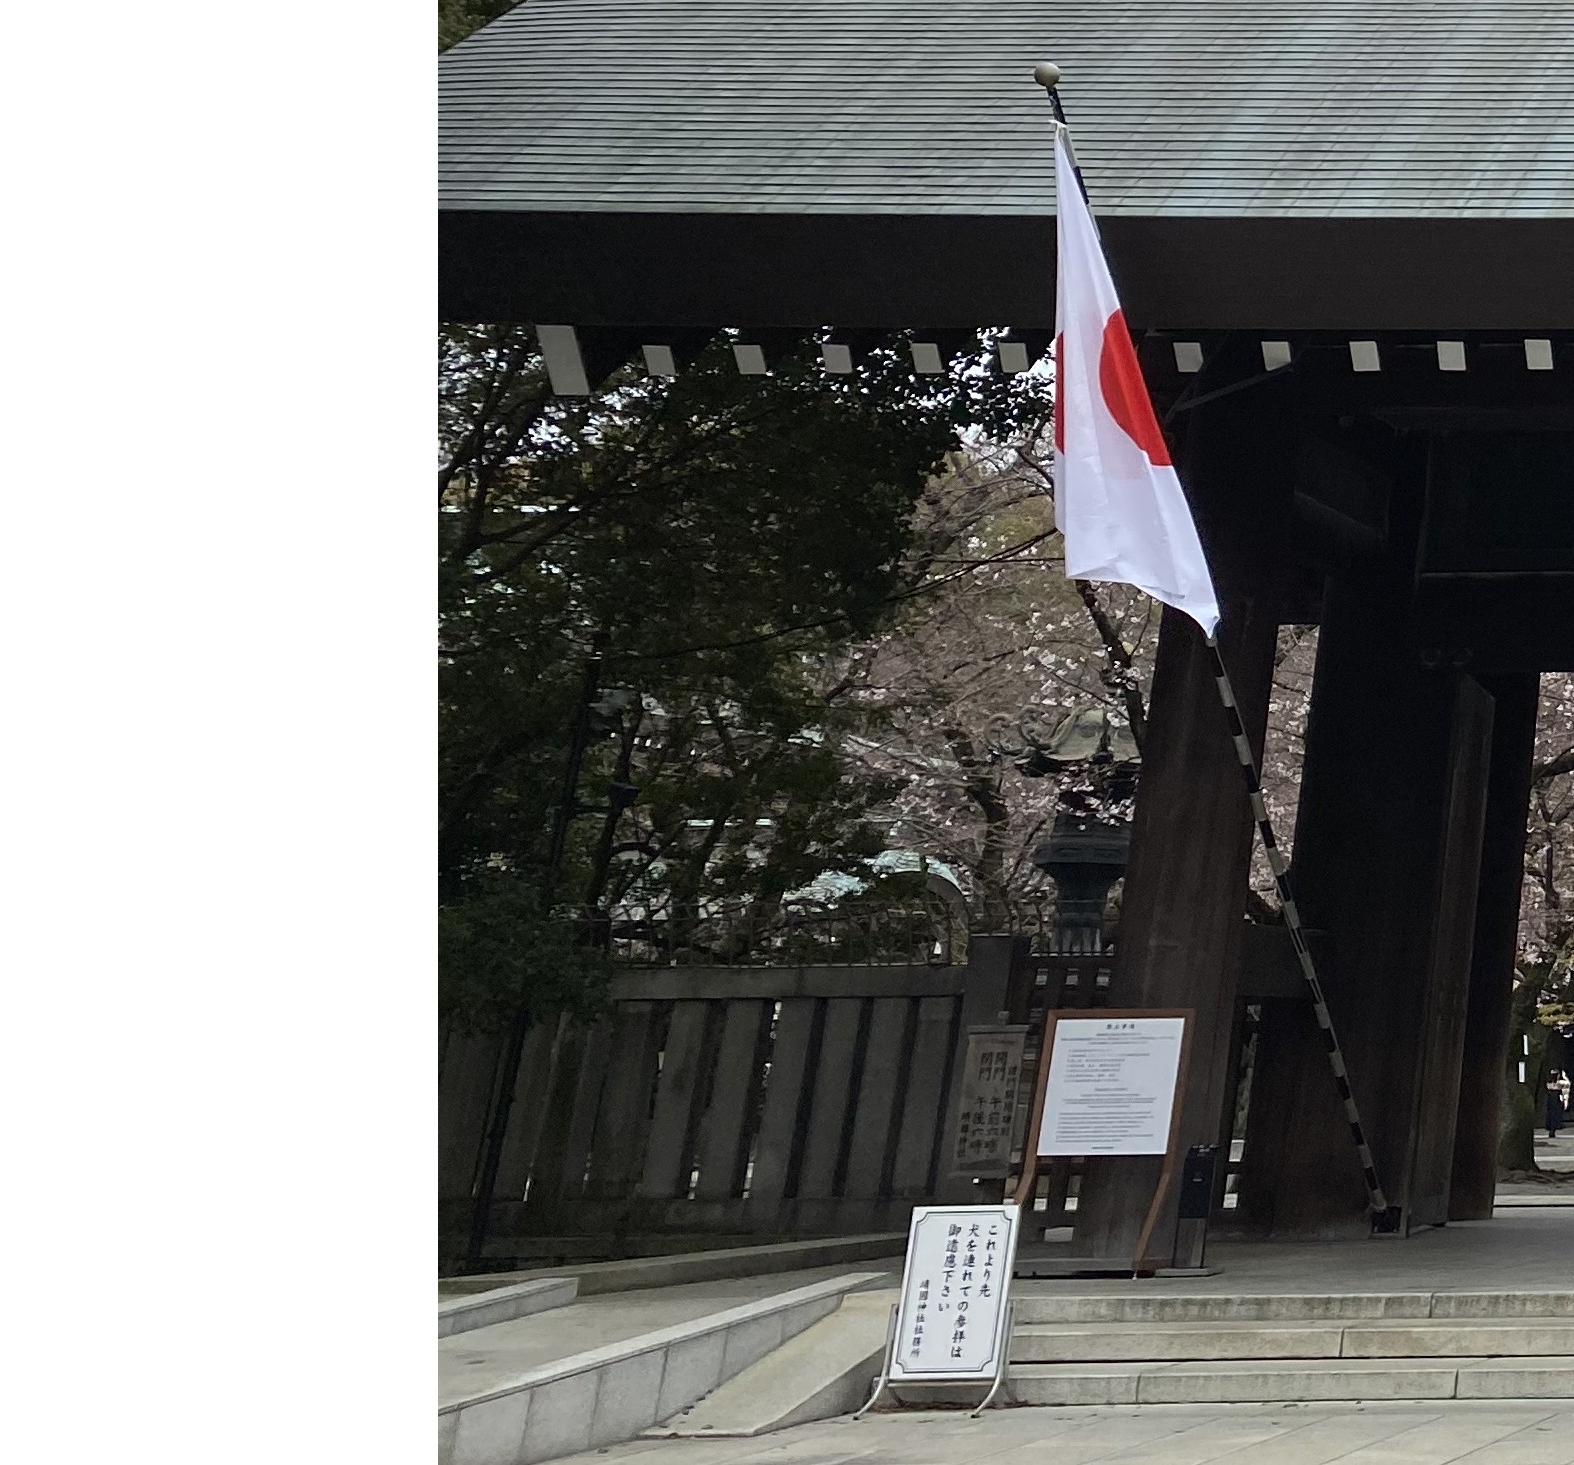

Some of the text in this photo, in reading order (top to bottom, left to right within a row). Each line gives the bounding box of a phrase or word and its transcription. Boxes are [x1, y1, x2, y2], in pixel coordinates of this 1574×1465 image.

[938, 1223, 962, 1312] 御遠慮下さい
[951, 1223, 980, 1358] 犬を連れての参拝は
[978, 1225, 998, 1298] これより先
